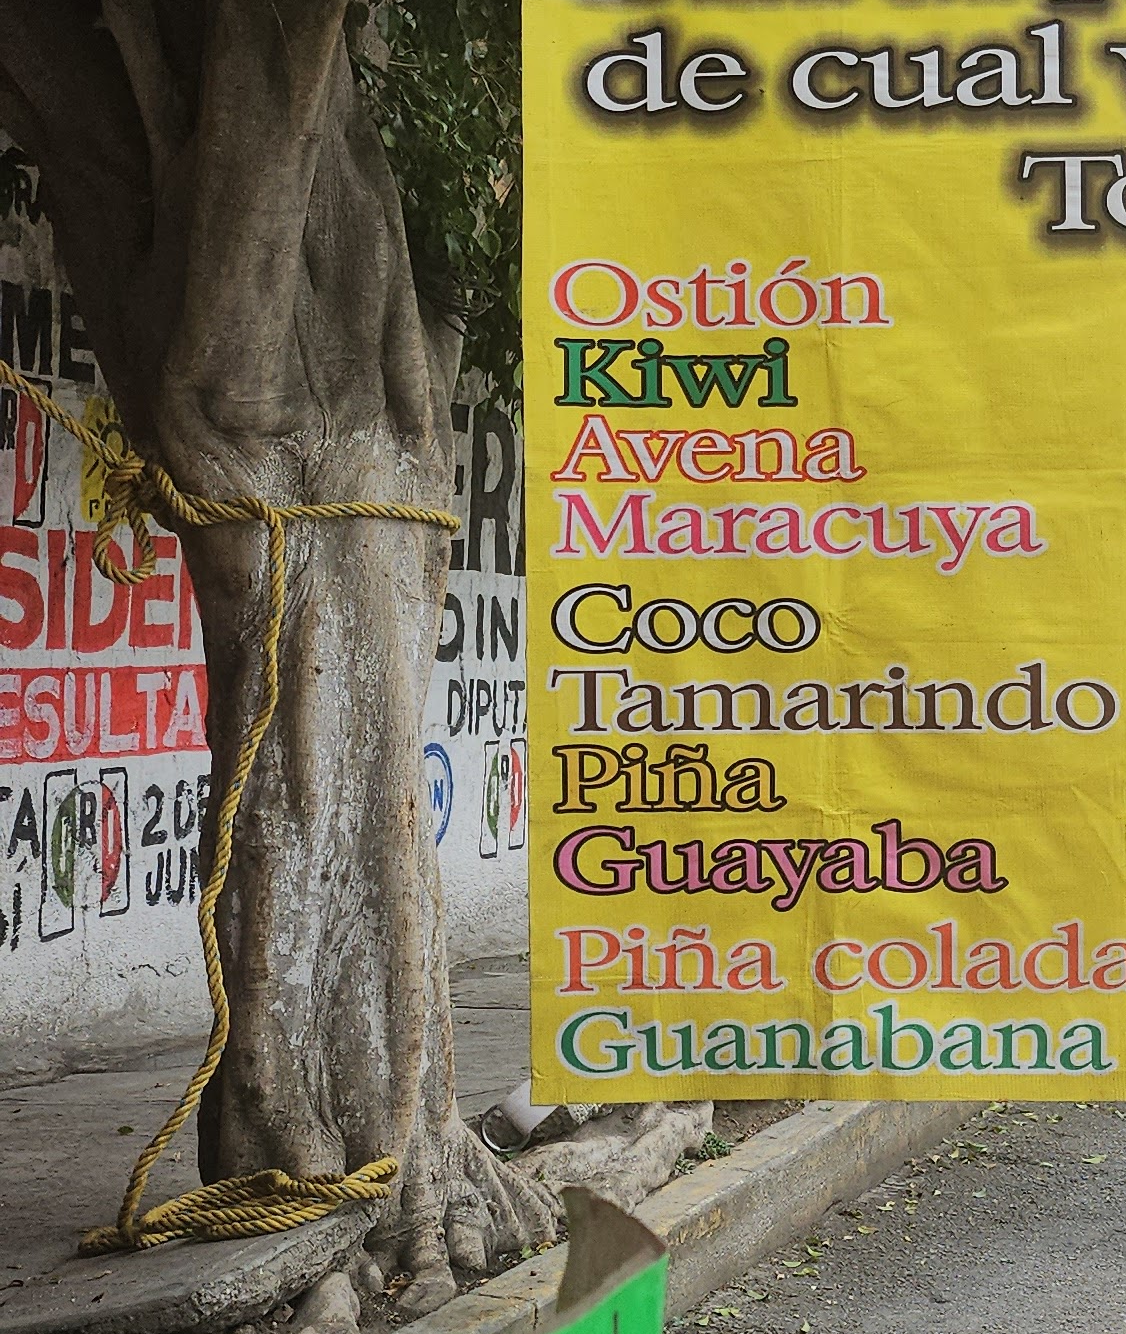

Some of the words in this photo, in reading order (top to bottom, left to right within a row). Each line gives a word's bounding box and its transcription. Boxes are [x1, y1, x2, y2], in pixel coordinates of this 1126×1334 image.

[584, 30, 748, 114] de
[790, 22, 1075, 110] cual
[550, 259, 890, 328] Ostión
[555, 337, 797, 407] Kiwi
[551, 415, 865, 482] Avena
[553, 491, 1044, 572] Maracuya
[550, 584, 822, 654] Coco
[447, 678, 528, 737] DIPUT
[550, 662, 1118, 733] Tamarindo
[553, 742, 787, 813] Piña
[554, 819, 1007, 913] Guayaba
[558, 927, 784, 995] Piña
[558, 1004, 1114, 1075] Guanabana
